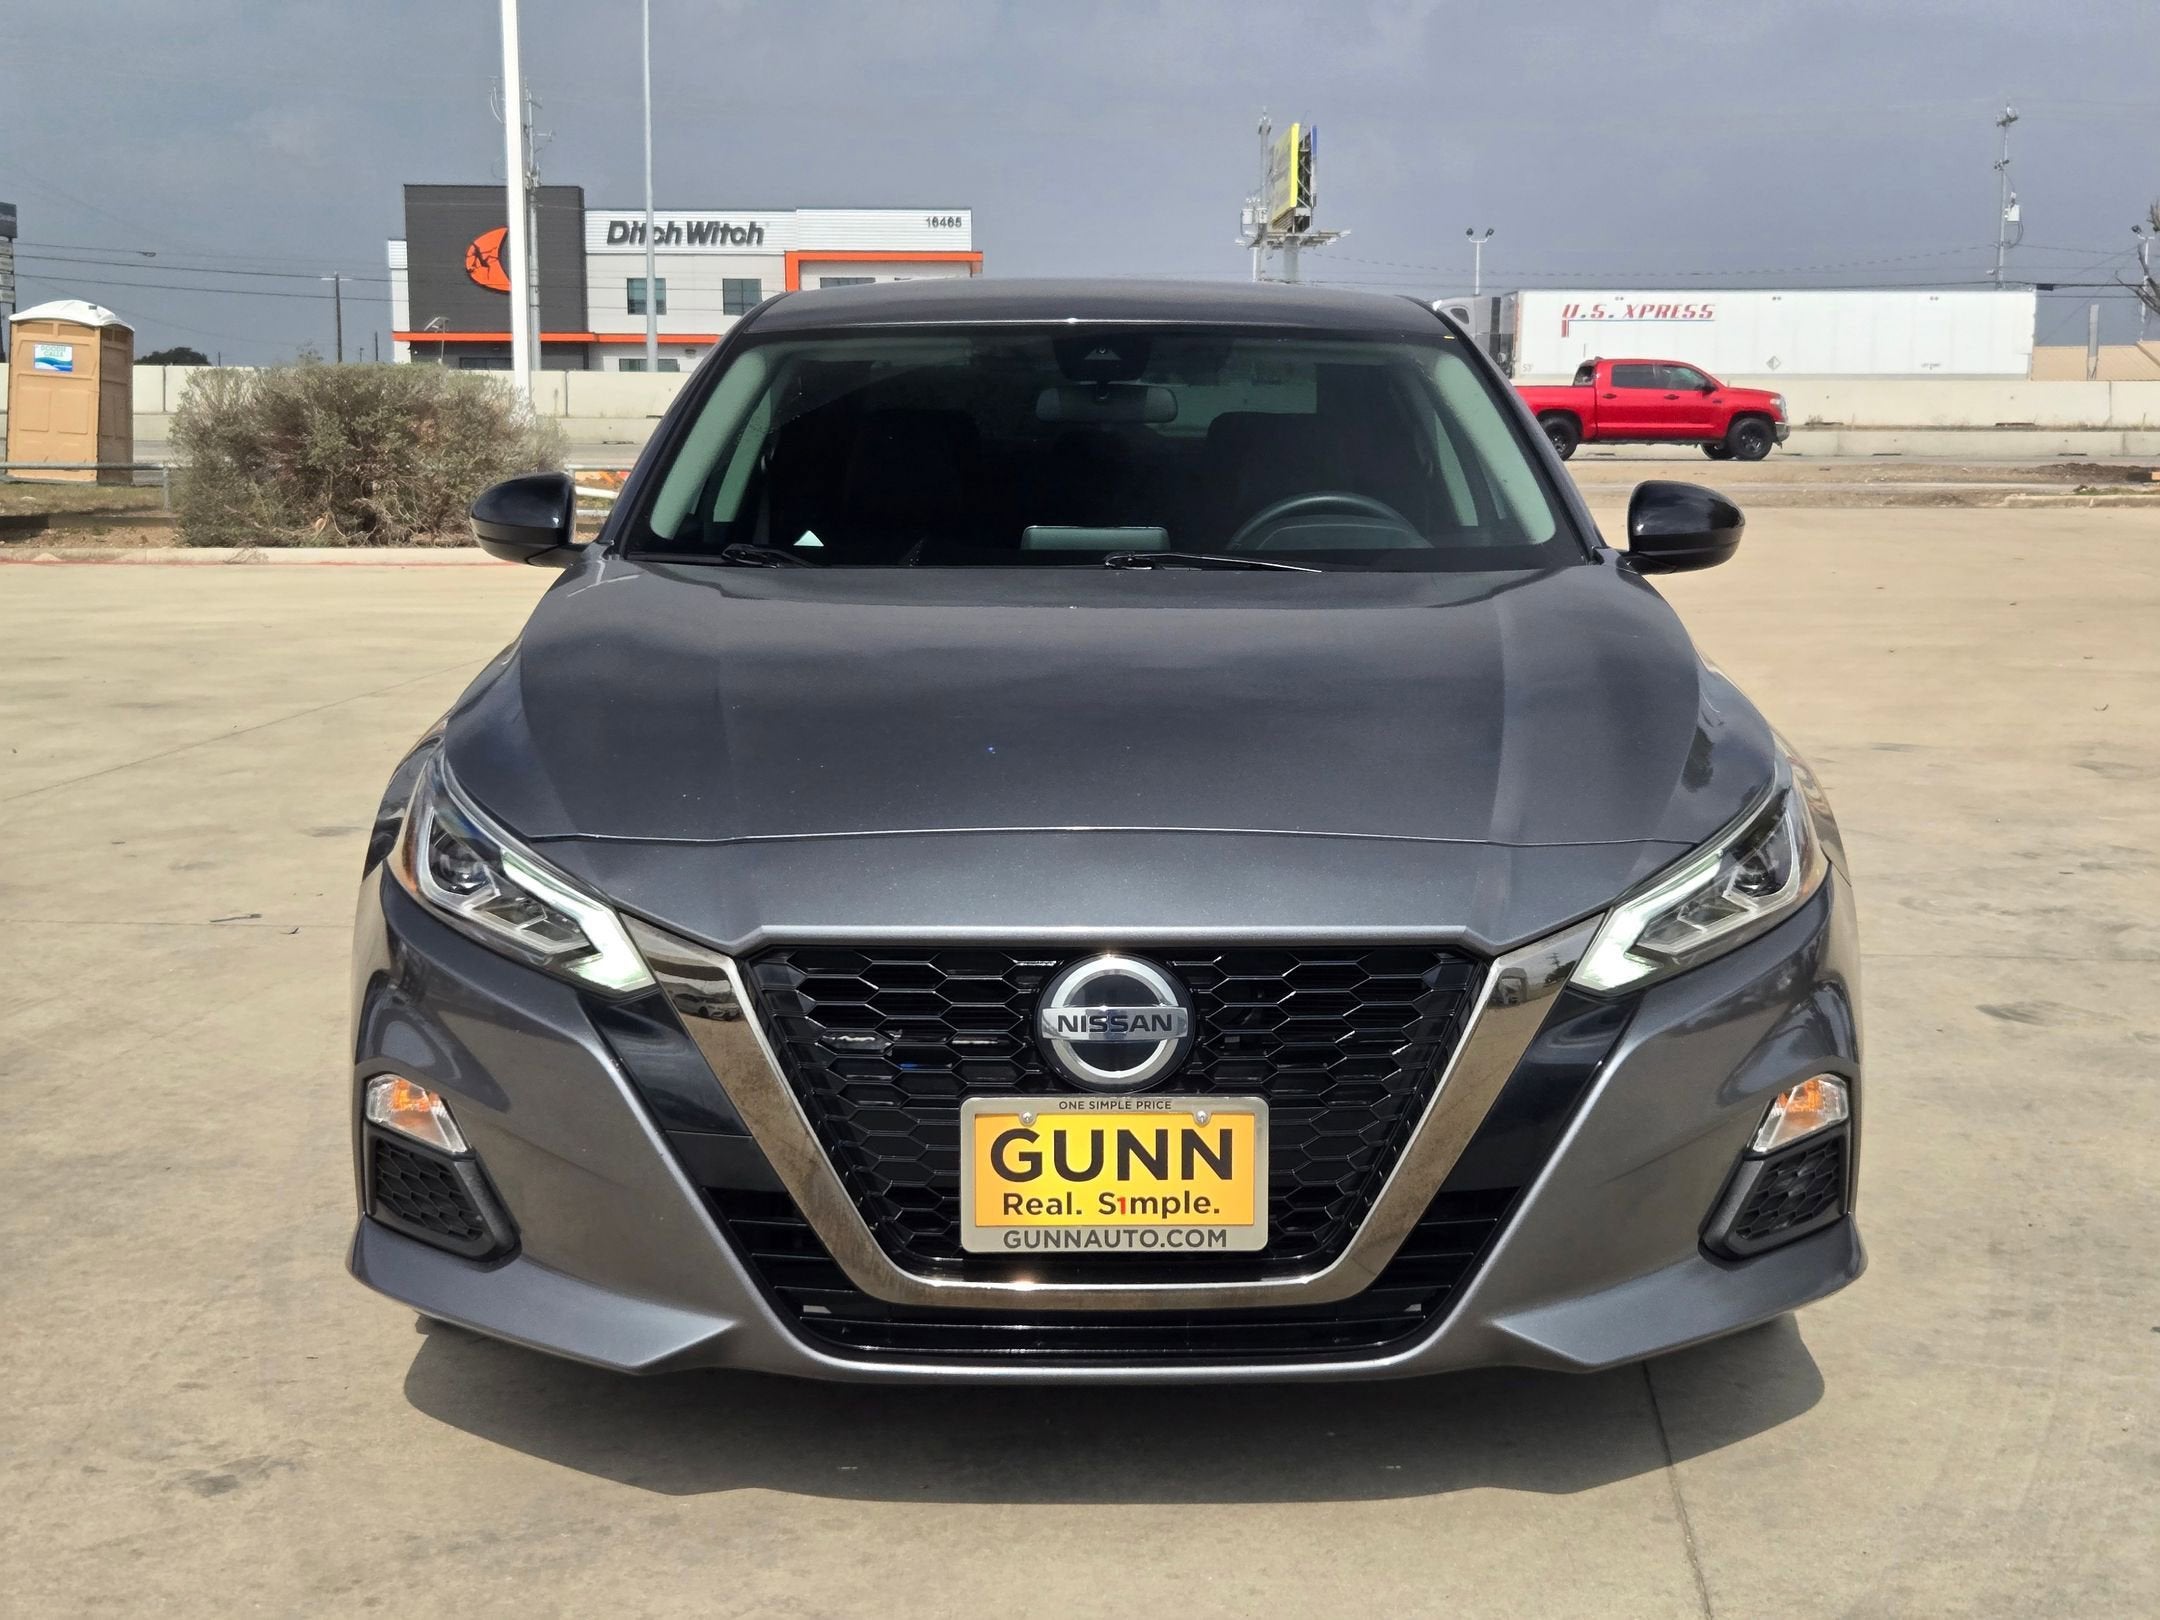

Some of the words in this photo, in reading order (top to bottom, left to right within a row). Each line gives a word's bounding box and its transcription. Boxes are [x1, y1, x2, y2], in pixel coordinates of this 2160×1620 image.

[926, 216, 962, 228] 16465
[607, 220, 683, 245] Ditch
[687, 220, 764, 245] Witch
[1562, 304, 1614, 319] U.S.
[1622, 304, 1715, 319] XPRESS
[1057, 1014, 1172, 1033] NISSAN
[1059, 1100, 1084, 1110] ONE
[1089, 1100, 1131, 1110] SIMPLE
[1136, 1100, 1172, 1110] PRICE
[990, 1128, 1233, 1183] GUNN
[1003, 1192, 1082, 1216] Real.
[1003, 1229, 1227, 1249] GUNNAUTO.COM
